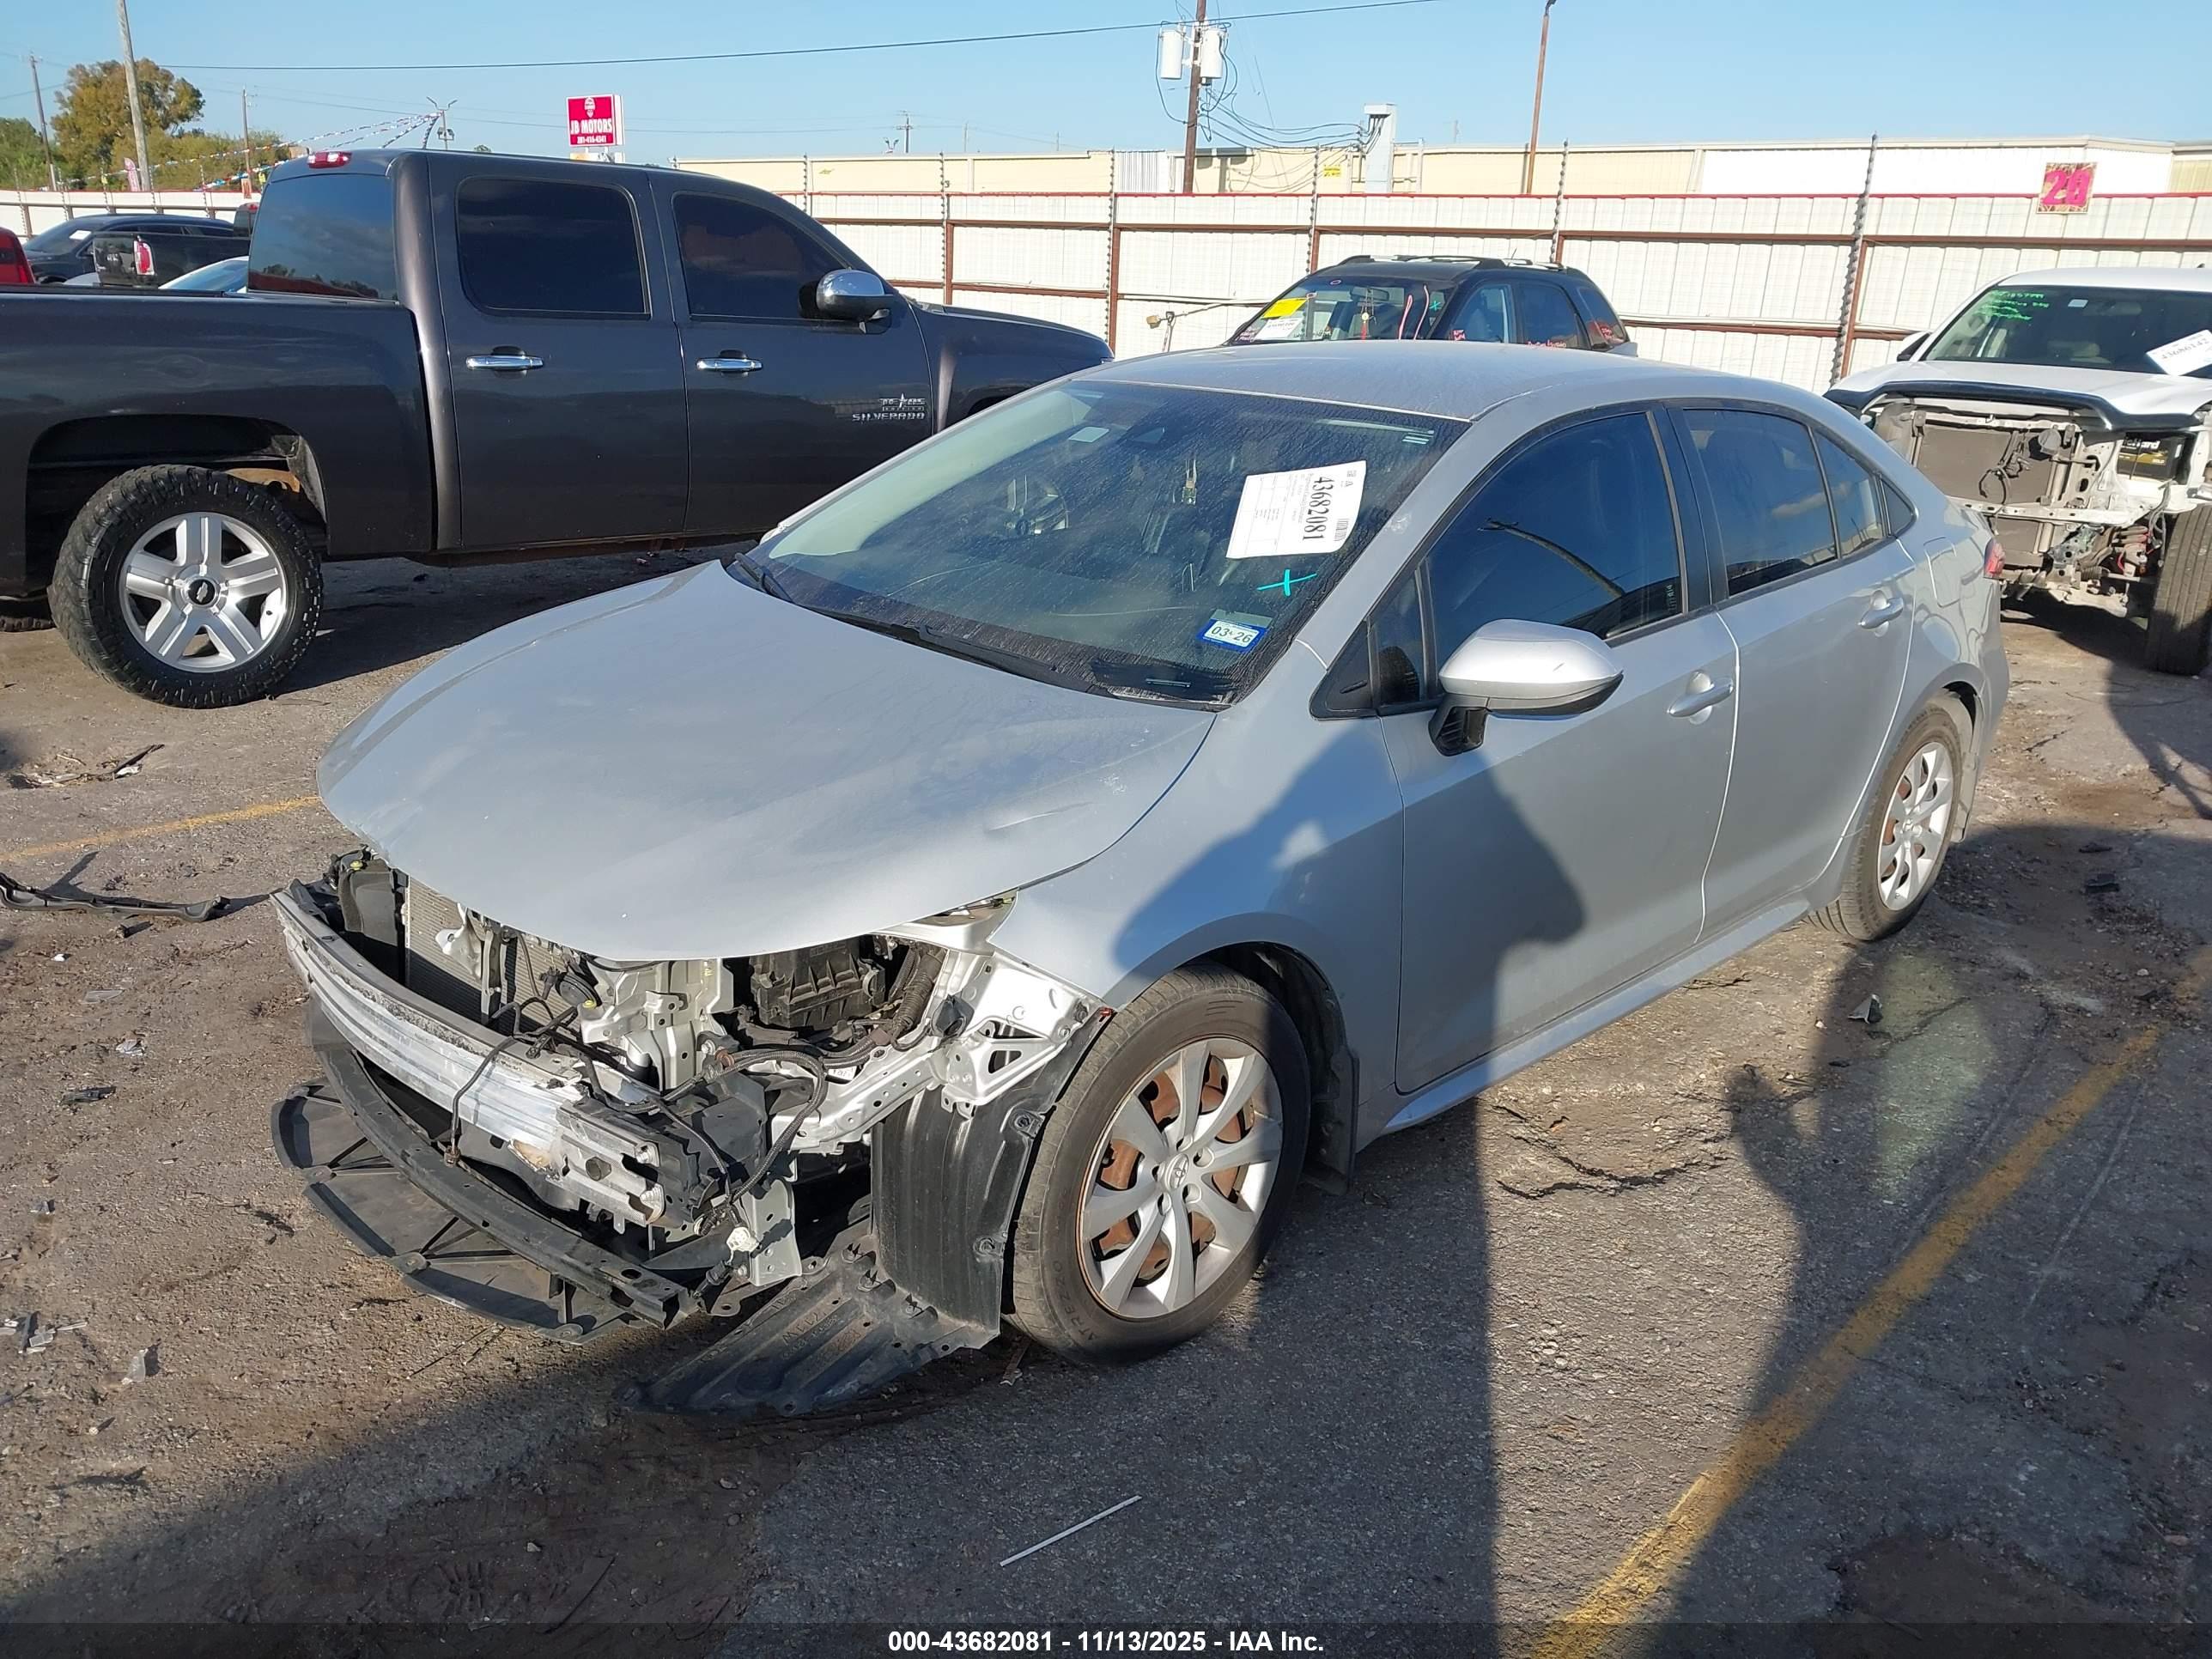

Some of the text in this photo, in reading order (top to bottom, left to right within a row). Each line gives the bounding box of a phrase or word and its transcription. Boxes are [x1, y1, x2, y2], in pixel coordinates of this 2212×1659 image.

[570, 118, 612, 135] JB MOTORS
[852, 412, 925, 422] SILVERADO
[1303, 476, 1334, 541] 43682081
[1211, 626, 1254, 643] 03 26
